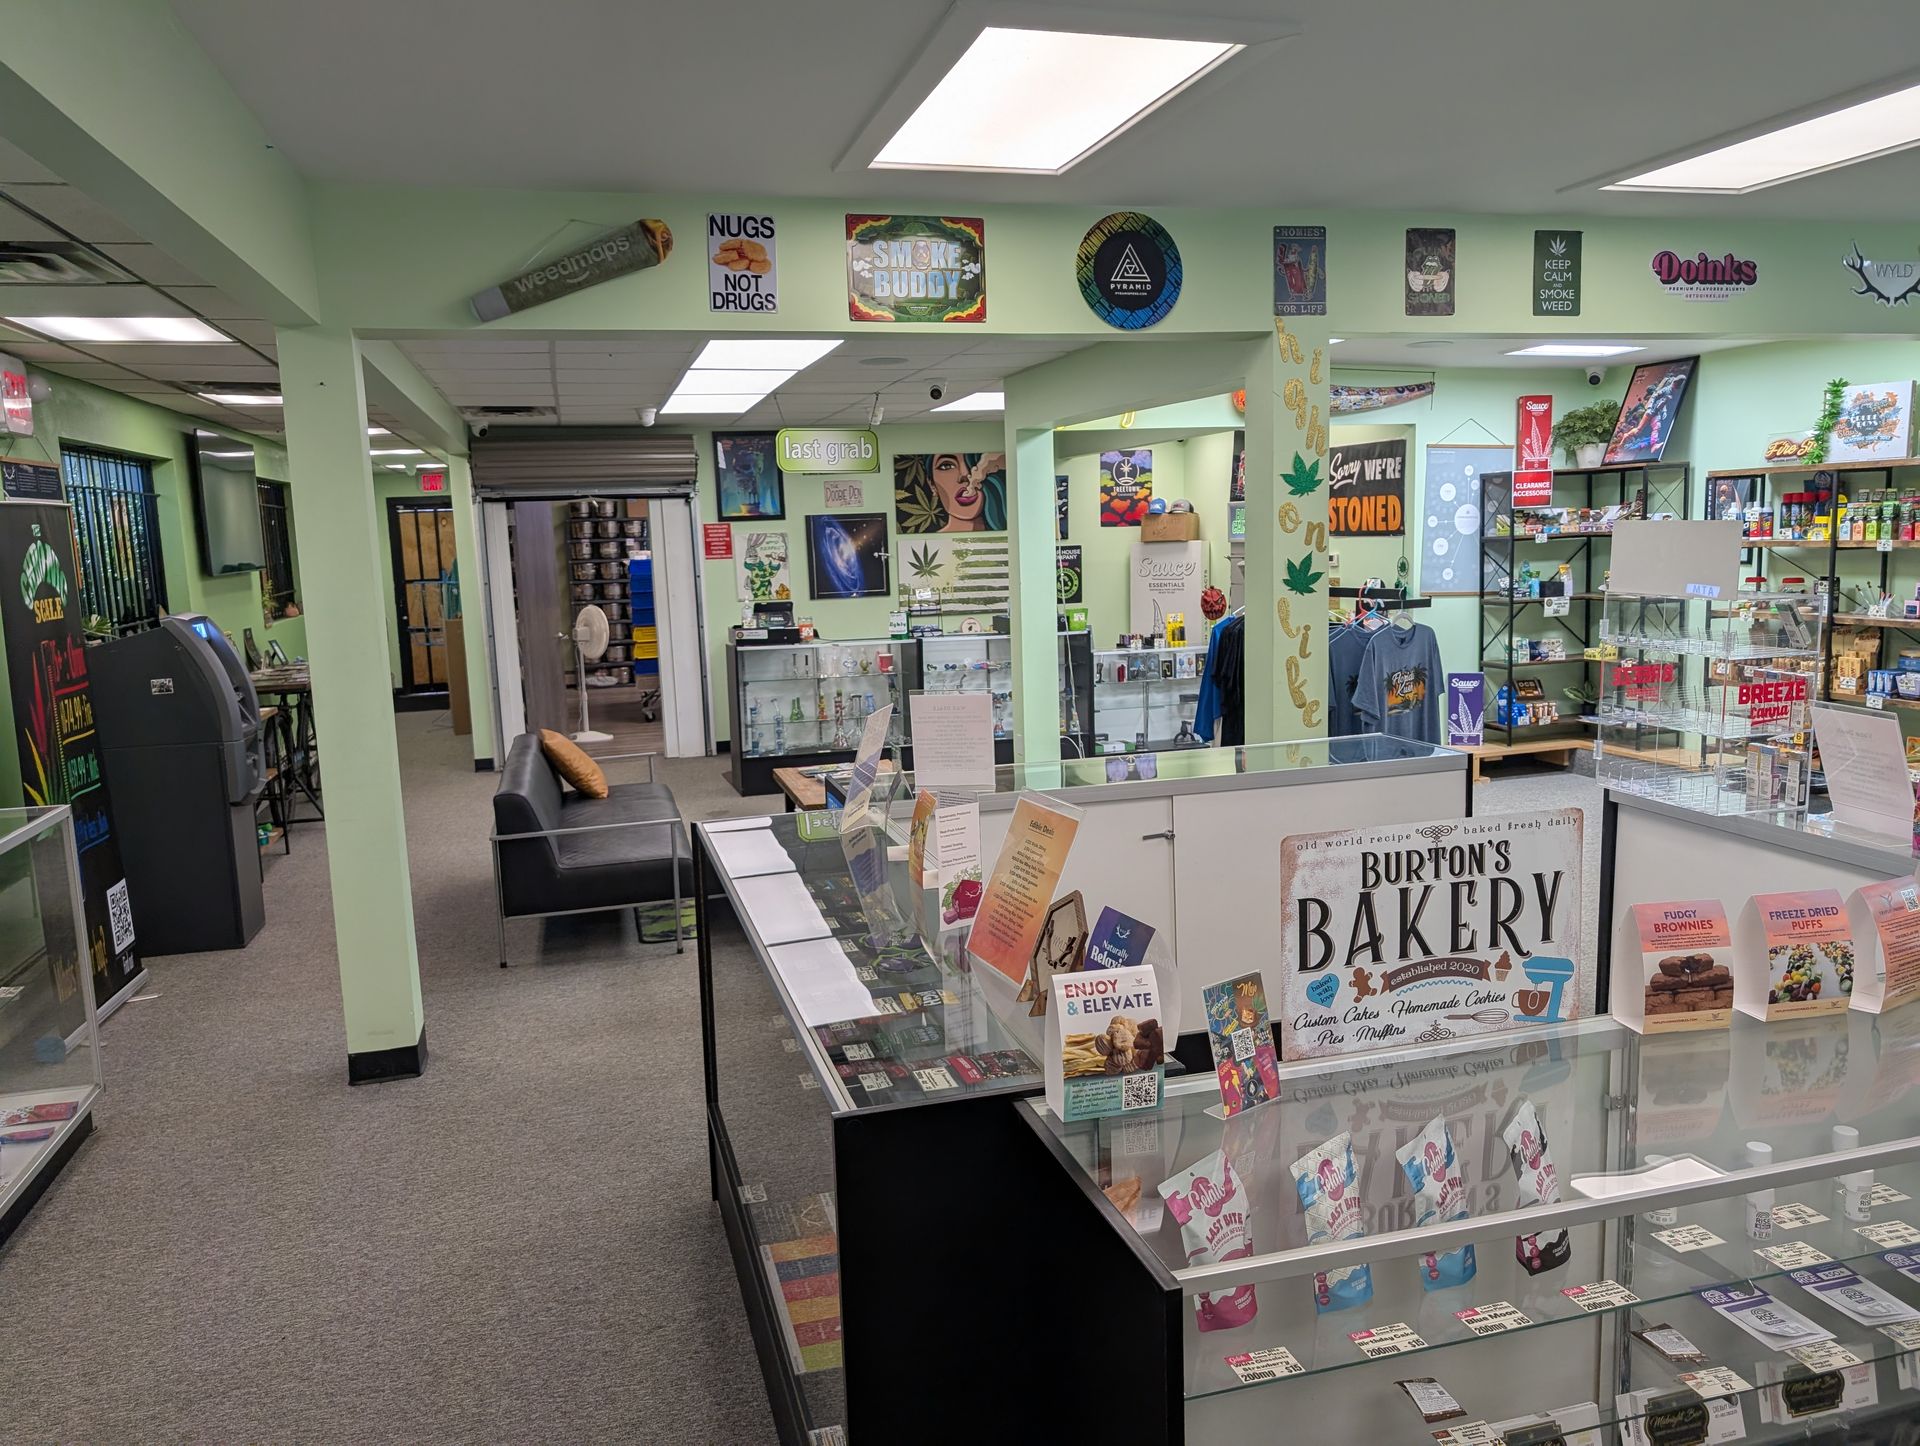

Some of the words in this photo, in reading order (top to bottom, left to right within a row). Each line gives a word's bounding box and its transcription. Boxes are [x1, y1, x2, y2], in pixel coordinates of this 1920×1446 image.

[709, 215, 775, 239] NUGS
[1281, 227, 1320, 237] HOMIES
[514, 234, 631, 293] weedmaps
[1545, 259, 1570, 269] KEEP
[1652, 251, 1757, 286] Doinks
[1876, 264, 1914, 278] WYLD
[724, 274, 763, 293] NOT
[873, 270, 959, 299] BUDDY
[1544, 271, 1572, 281] CALM
[712, 292, 776, 311] DRUGS
[1540, 289, 1575, 300] SMOKE
[1278, 305, 1298, 314] FOR
[1301, 304, 1323, 313] LIFE
[1542, 301, 1572, 311] WEED
[785, 437, 821, 459] last
[826, 436, 873, 465] grab
[1329, 453, 1361, 485] Sorry
[1364, 457, 1402, 480] WE'RE
[1329, 495, 1402, 532] STONED
[1138, 557, 1196, 578] Sauce
[1693, 586, 1714, 596] MTA
[1451, 678, 1480, 688] Sauce
[1738, 680, 1806, 704] BREEZE
[1029, 820, 1043, 831] Edible
[1463, 823, 1501, 835] baked
[1507, 819, 1542, 832] fresh
[1547, 815, 1579, 828] daily
[1297, 841, 1318, 851] old
[1325, 836, 1363, 848] world
[1370, 832, 1412, 845] recipe
[1361, 839, 1512, 890] BURTON'S
[1297, 869, 1565, 974] BAKERY
[1664, 909, 1697, 920] FUDGY
[1769, 909, 1806, 921] FREEZE
[1808, 906, 1839, 918] DRIED
[1654, 919, 1714, 933] BROWNIES
[1791, 920, 1823, 930] PUFFS
[1103, 940, 1129, 960] Naturally
[1390, 961, 1447, 986] established
[1449, 961, 1480, 975] 2020
[1064, 979, 1118, 998] ENJOY
[1311, 976, 1332, 992] baked
[1316, 985, 1333, 997] with
[1066, 1001, 1079, 1016] &
[1083, 992, 1153, 1014] ELEVATE
[1320, 992, 1335, 1004] love
[1293, 1013, 1338, 1031] Custom
[1343, 1006, 1380, 1024] Cakes
[1464, 990, 1506, 1008] Cookies
[1206, 1221, 1224, 1243] LAST
[1224, 1212, 1243, 1226] BITE
[1583, 1299, 1616, 1312] 200mg
[1621, 1294, 1638, 1303] $15
[1709, 1294, 1731, 1304] RISE
[1846, 1292, 1867, 1302] RISE
[1465, 1316, 1488, 1325] Blue
[1489, 1309, 1519, 1320] Moon
[1756, 1310, 1776, 1321] RISE
[1474, 1322, 1506, 1335] 200mg
[1513, 1317, 1531, 1326] $15
[1357, 1336, 1394, 1347] Birthday
[1367, 1344, 1401, 1358] 200mg
[1409, 1339, 1425, 1348] $15
[1241, 1369, 1275, 1383] 200mg
[1286, 1364, 1303, 1374] $15
[1243, 1361, 1290, 1372] Strawberry
